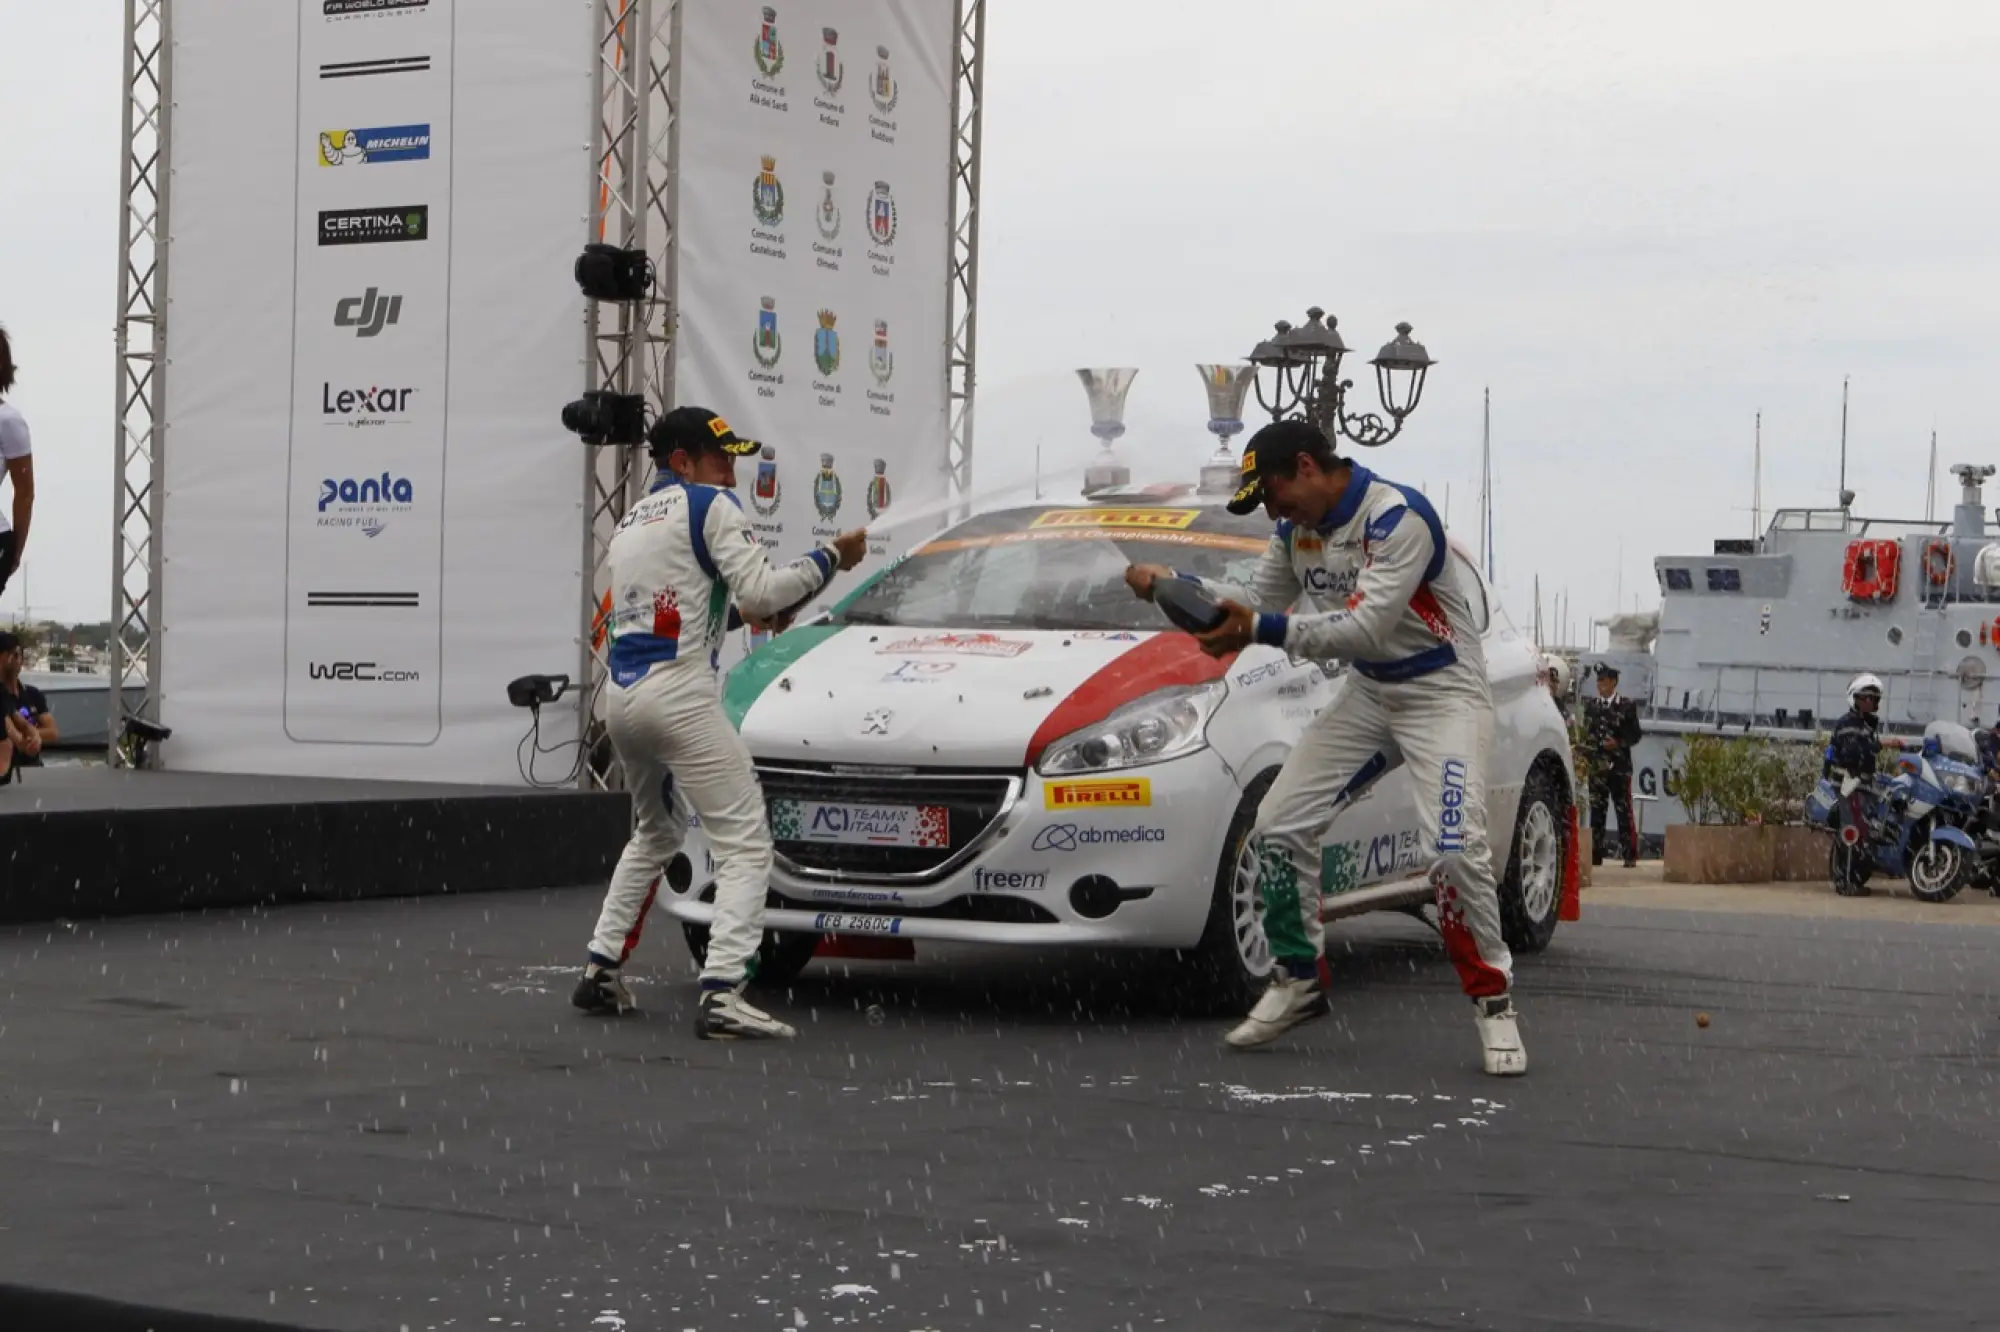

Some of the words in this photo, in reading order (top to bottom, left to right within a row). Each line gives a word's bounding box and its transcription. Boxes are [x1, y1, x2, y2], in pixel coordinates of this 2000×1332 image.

[366, 135, 429, 150] MICHELIN
[324, 213, 403, 231] CERTINA
[751, 227, 777, 243] Comune
[812, 241, 834, 257] Comune
[867, 249, 888, 264] Comune
[749, 369, 776, 384] Comune
[812, 380, 835, 393] Comune
[323, 382, 413, 414] Lexar
[866, 389, 888, 403] Comune
[318, 471, 413, 513] panta
[316, 516, 353, 528] RACING
[812, 524, 836, 537] Comune
[1053, 783, 1140, 804] PIRELLI
[1437, 758, 1466, 854] freem
[849, 821, 900, 834] ITALIA
[975, 865, 1046, 891] freem
[824, 913, 842, 928] FB
